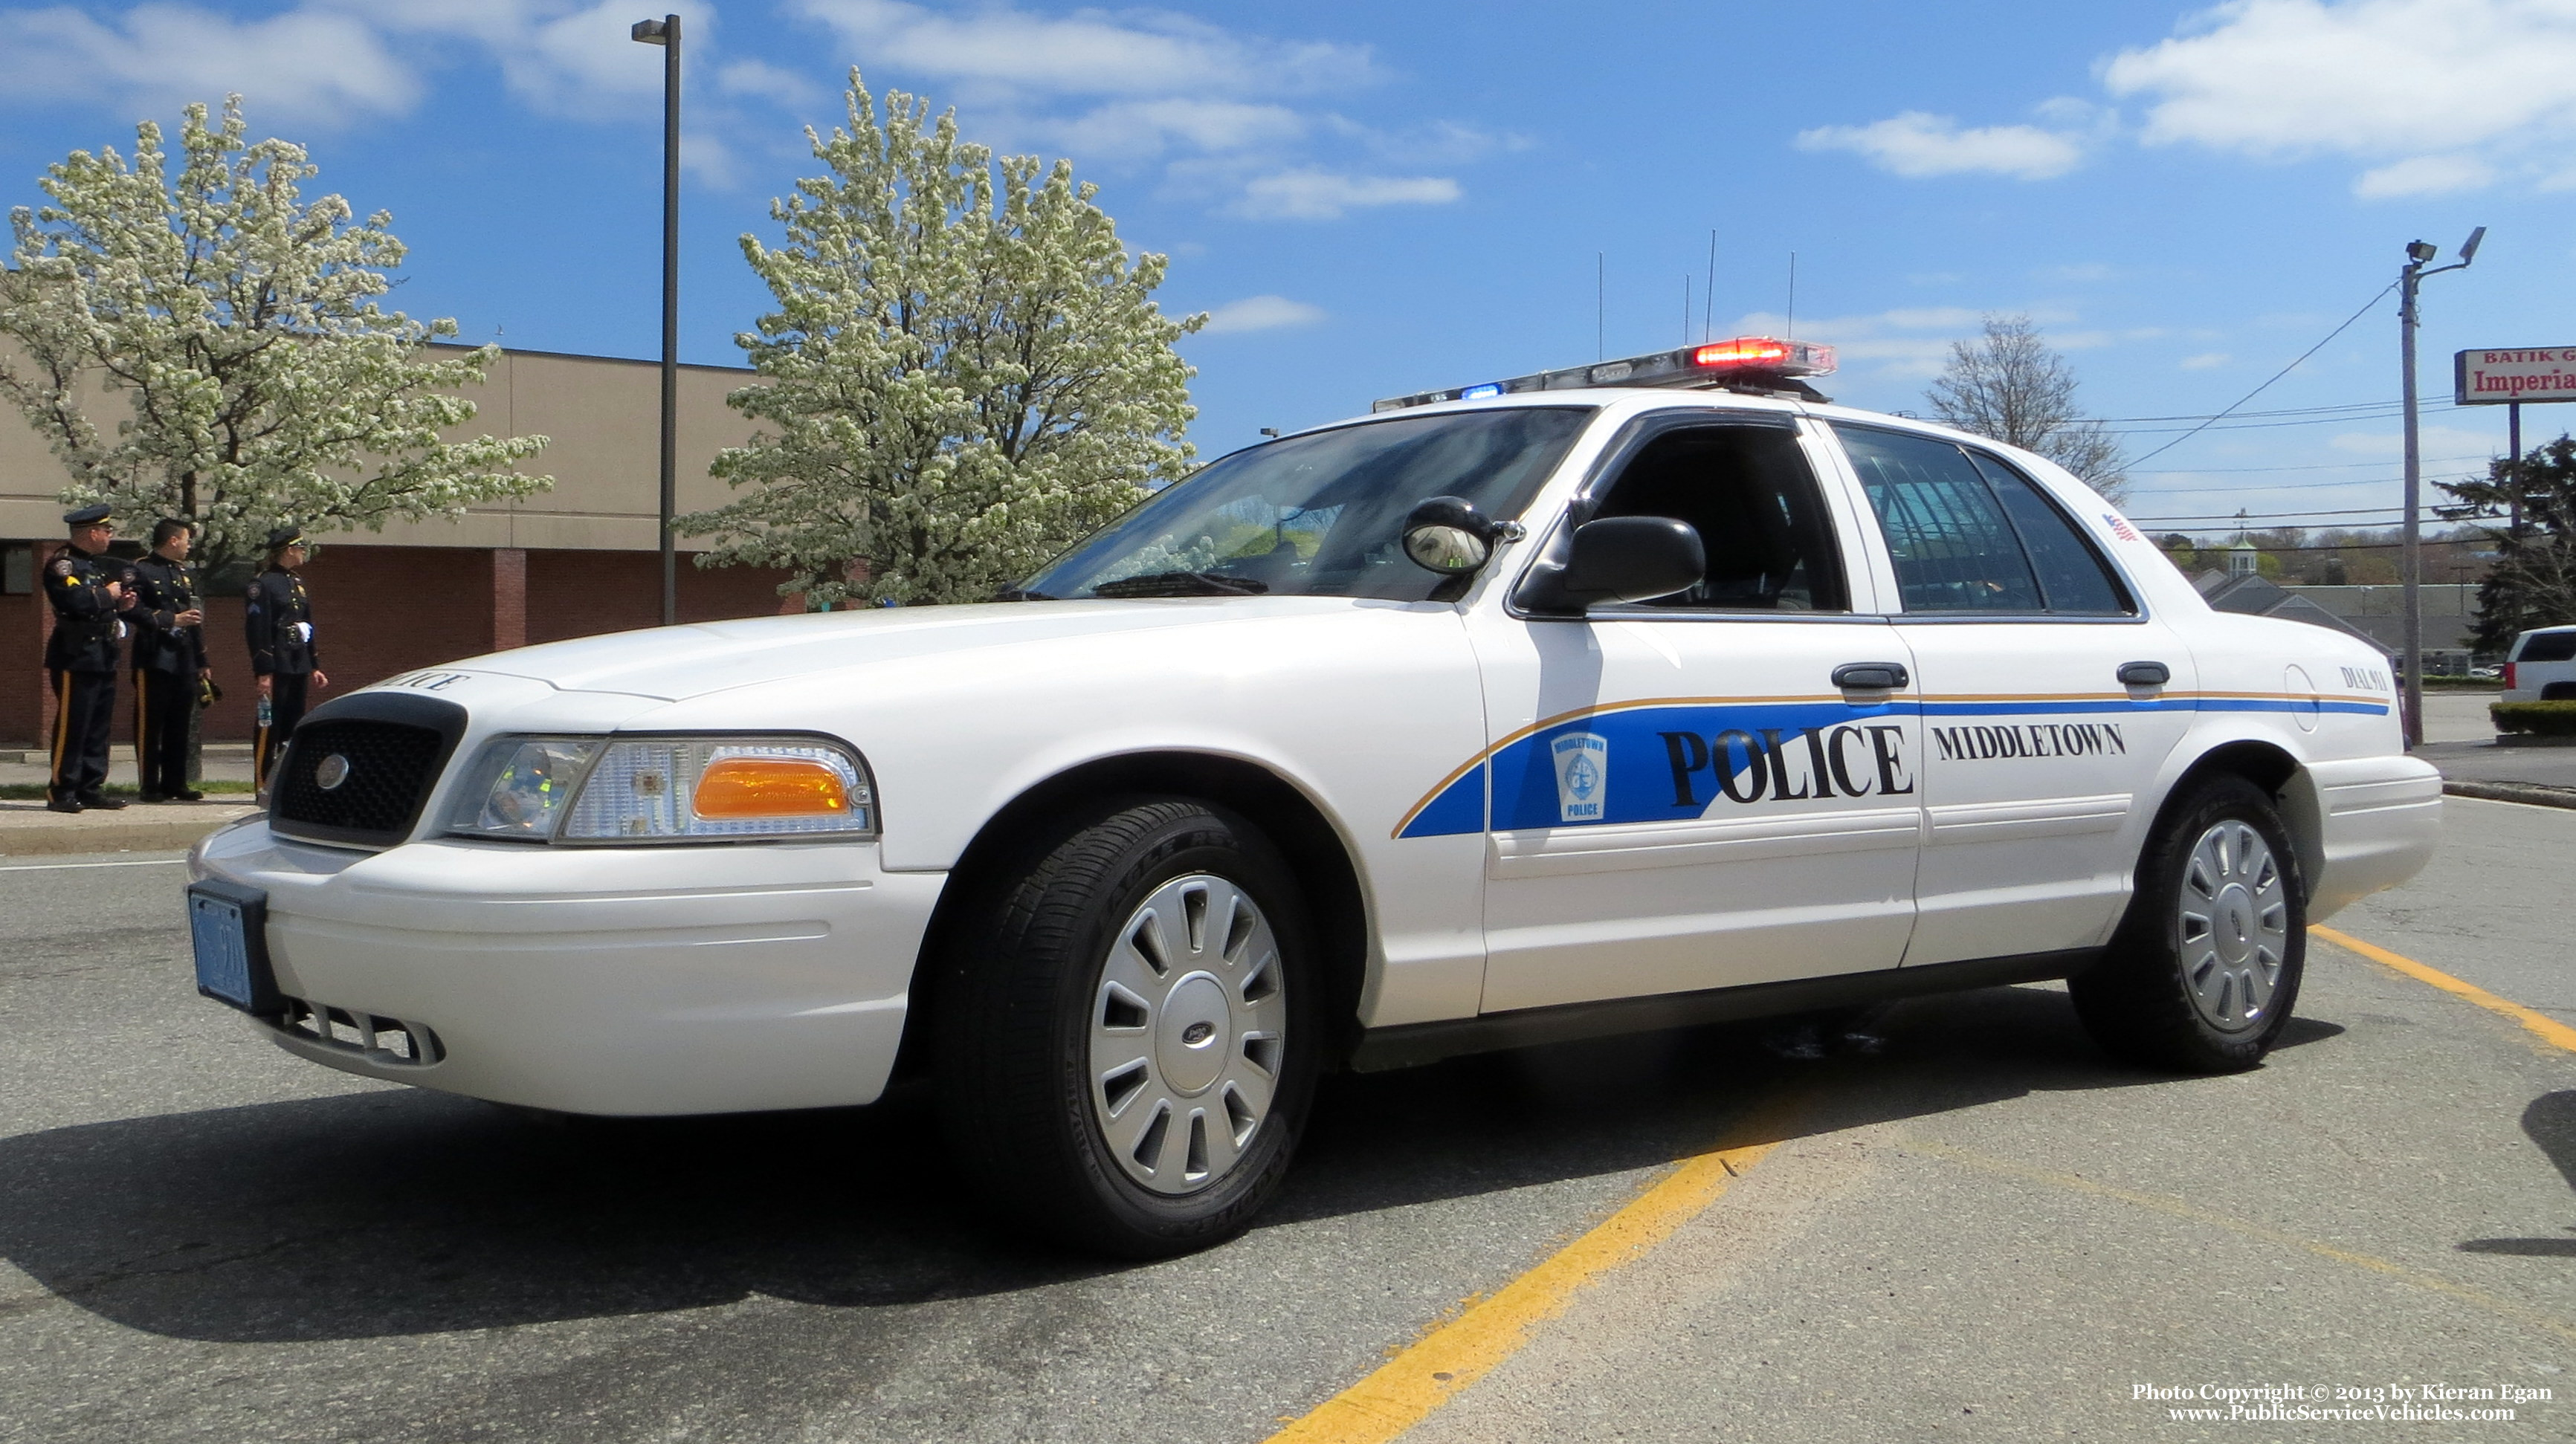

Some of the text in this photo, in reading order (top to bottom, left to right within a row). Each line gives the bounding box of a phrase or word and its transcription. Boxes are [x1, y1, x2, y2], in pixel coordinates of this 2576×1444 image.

[2485, 351, 2554, 363] BATIK
[2340, 667, 2388, 691] DIAL 911
[1554, 737, 1604, 754] MIDDLETOWN
[1931, 724, 2126, 761] MIDDLETOWN
[1656, 725, 1914, 806] POLICE
[1567, 803, 1598, 816] POLICE
